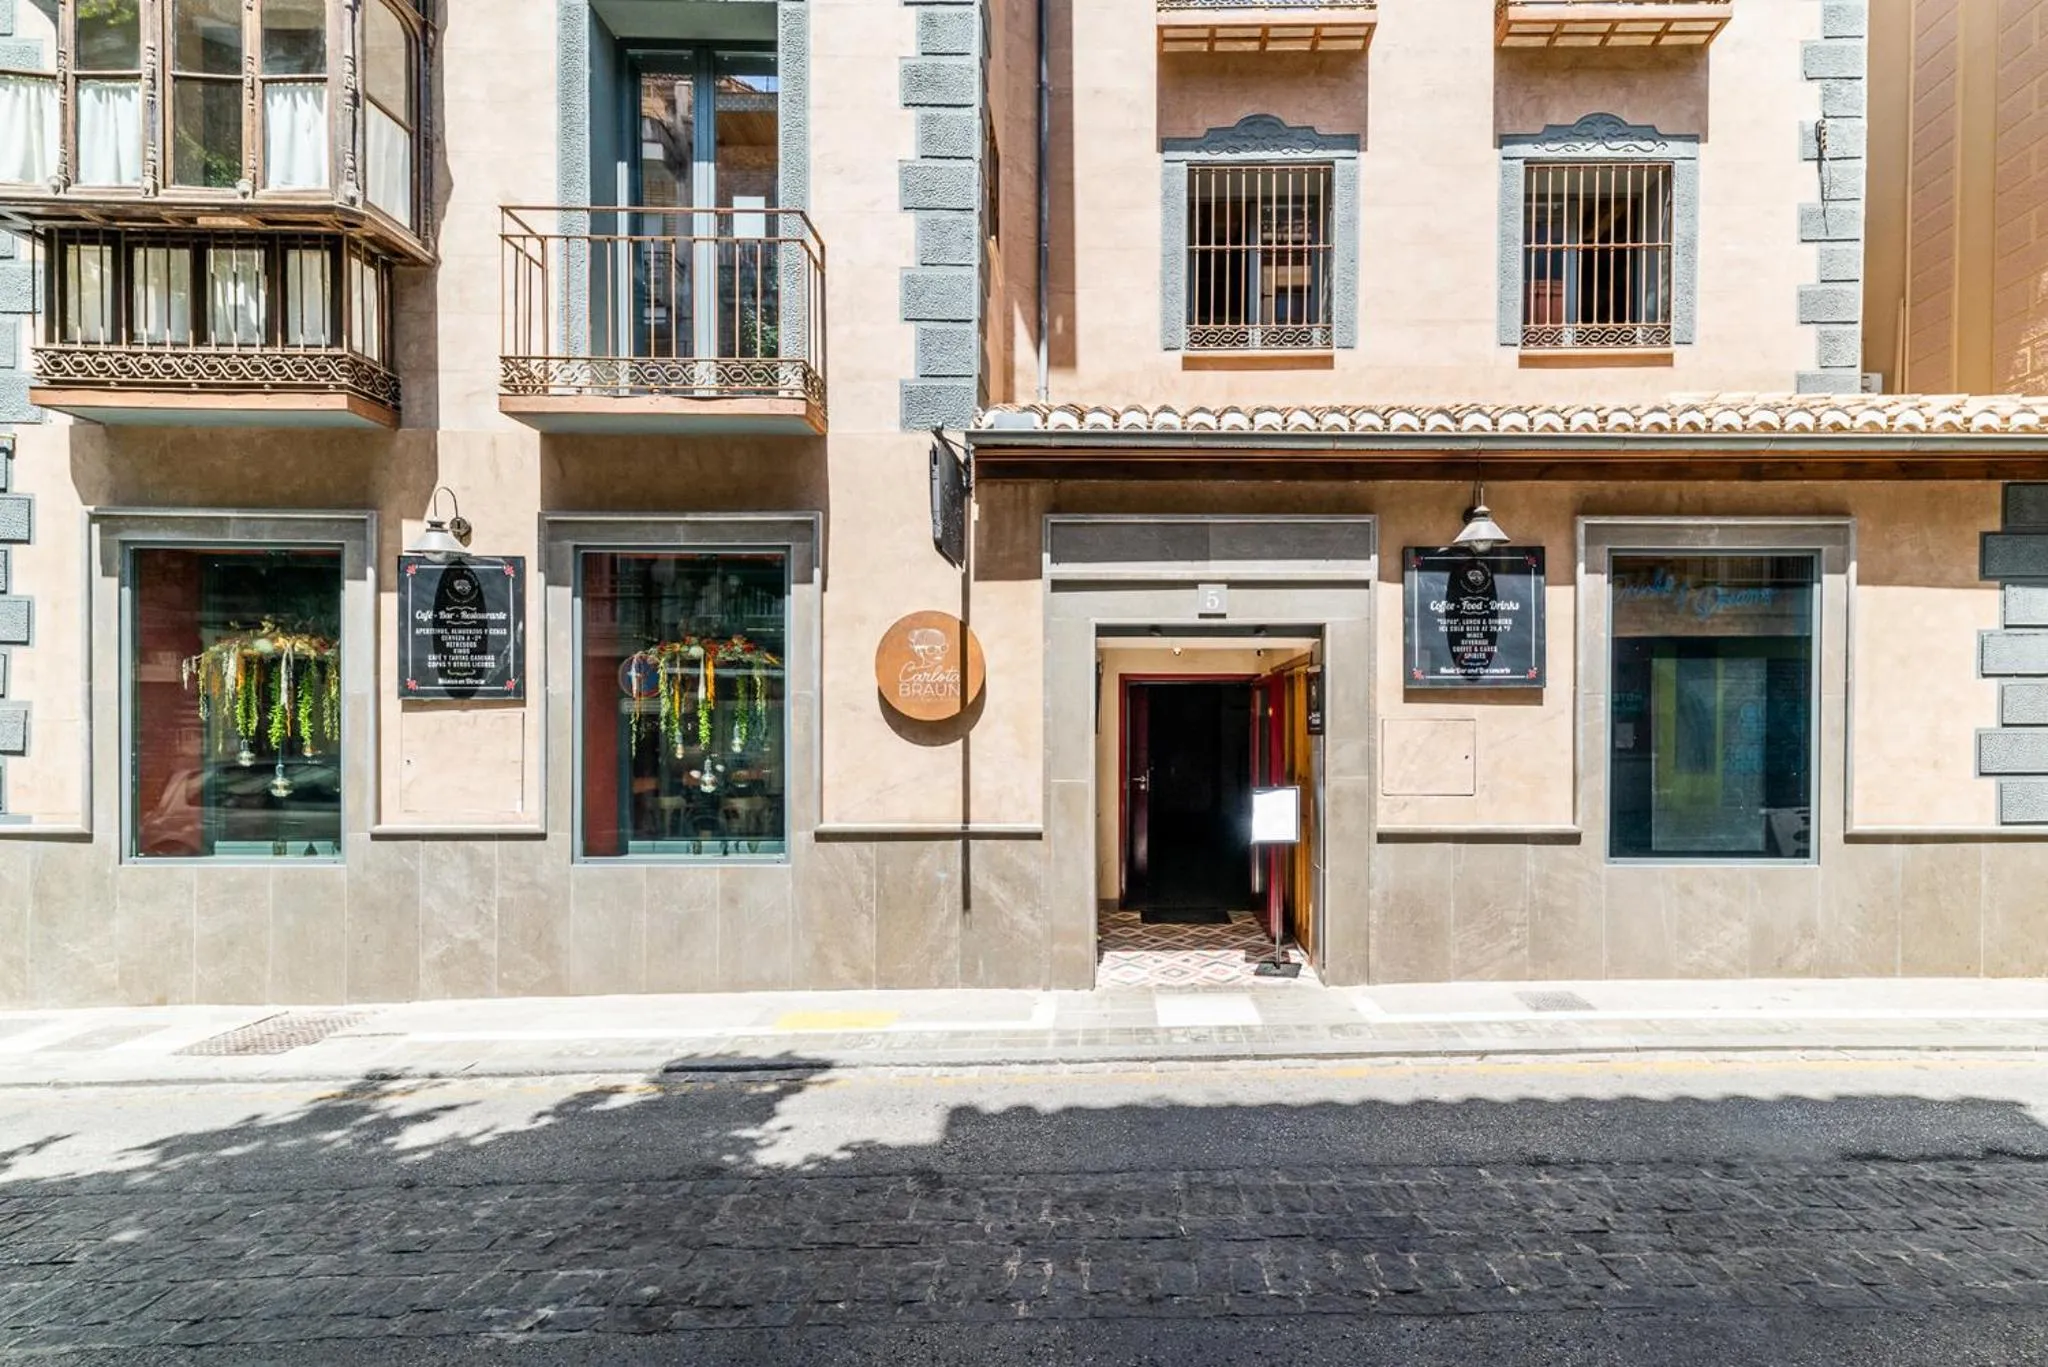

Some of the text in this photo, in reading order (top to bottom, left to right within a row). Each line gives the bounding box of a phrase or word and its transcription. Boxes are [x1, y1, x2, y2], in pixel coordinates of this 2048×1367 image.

[1206, 591, 1219, 609] 5
[1430, 600, 1455, 613] Coffee
[1461, 601, 1483, 610] Food
[1489, 600, 1520, 610] Drinks
[416, 611, 433, 621] Café
[438, 611, 455, 619] Bar
[461, 611, 507, 620] Restaurante
[899, 661, 960, 682] Carlota
[899, 683, 960, 697] BRAUN
